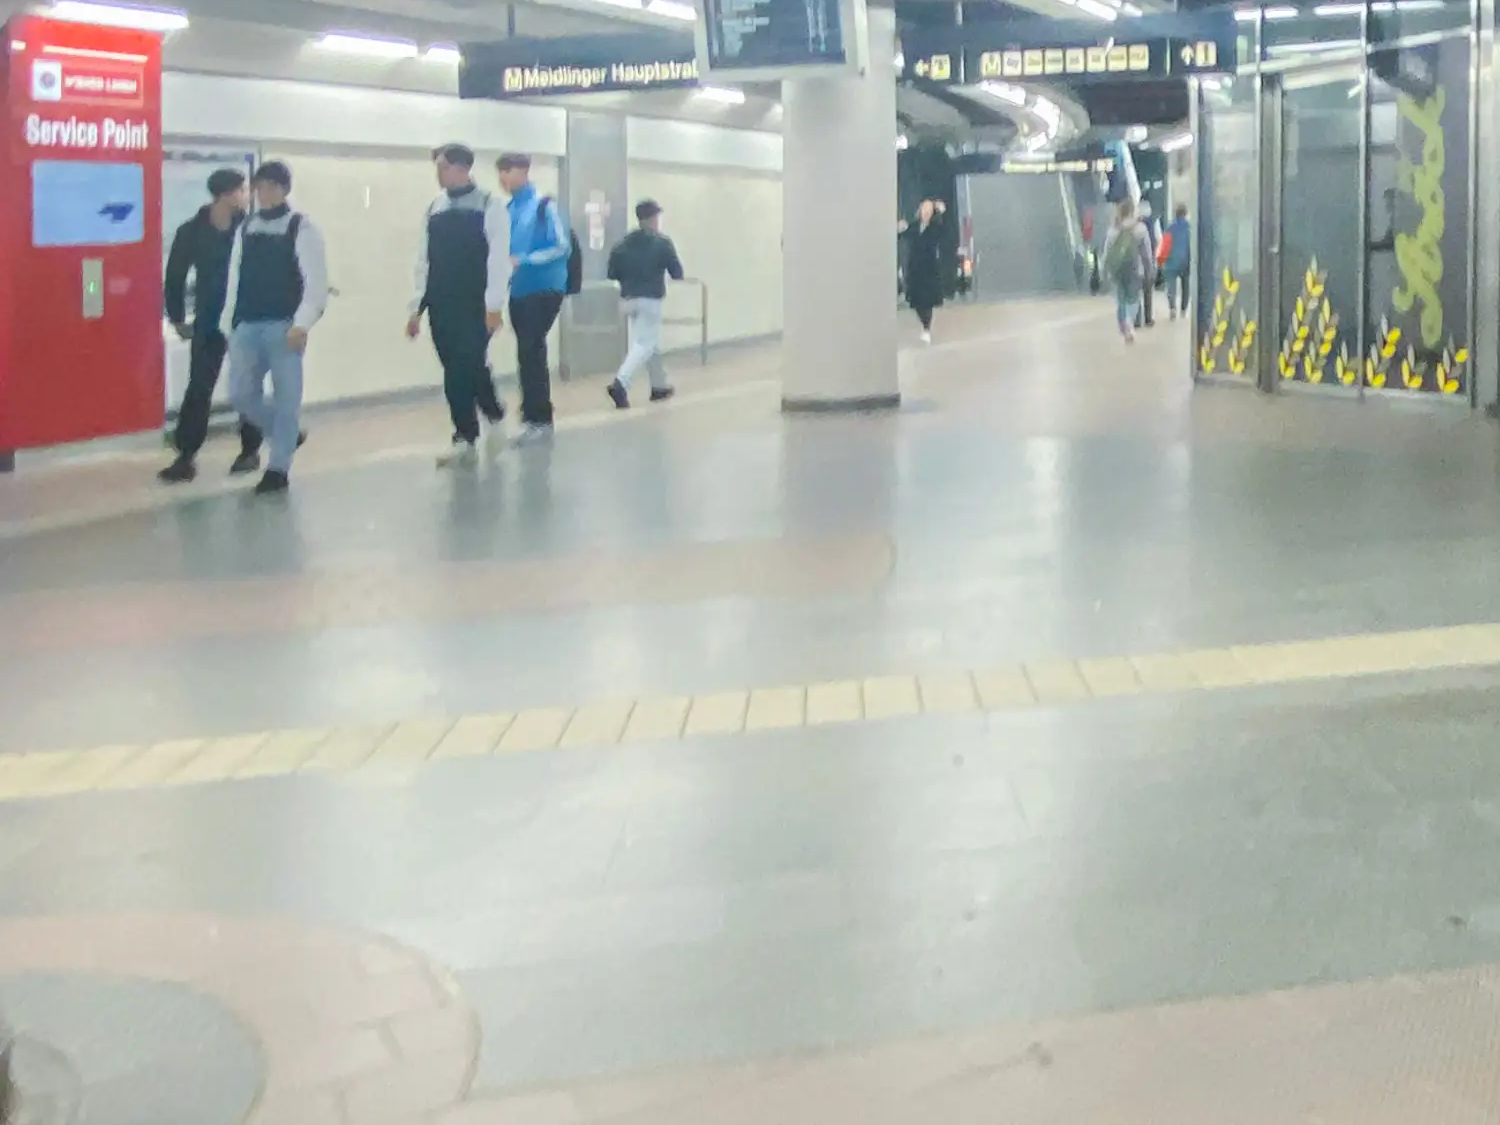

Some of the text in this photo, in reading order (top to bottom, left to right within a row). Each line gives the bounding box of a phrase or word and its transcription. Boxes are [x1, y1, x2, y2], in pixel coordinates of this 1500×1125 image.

[523, 65, 608, 88] Meidlinger
[26, 113, 148, 151] Service Point
